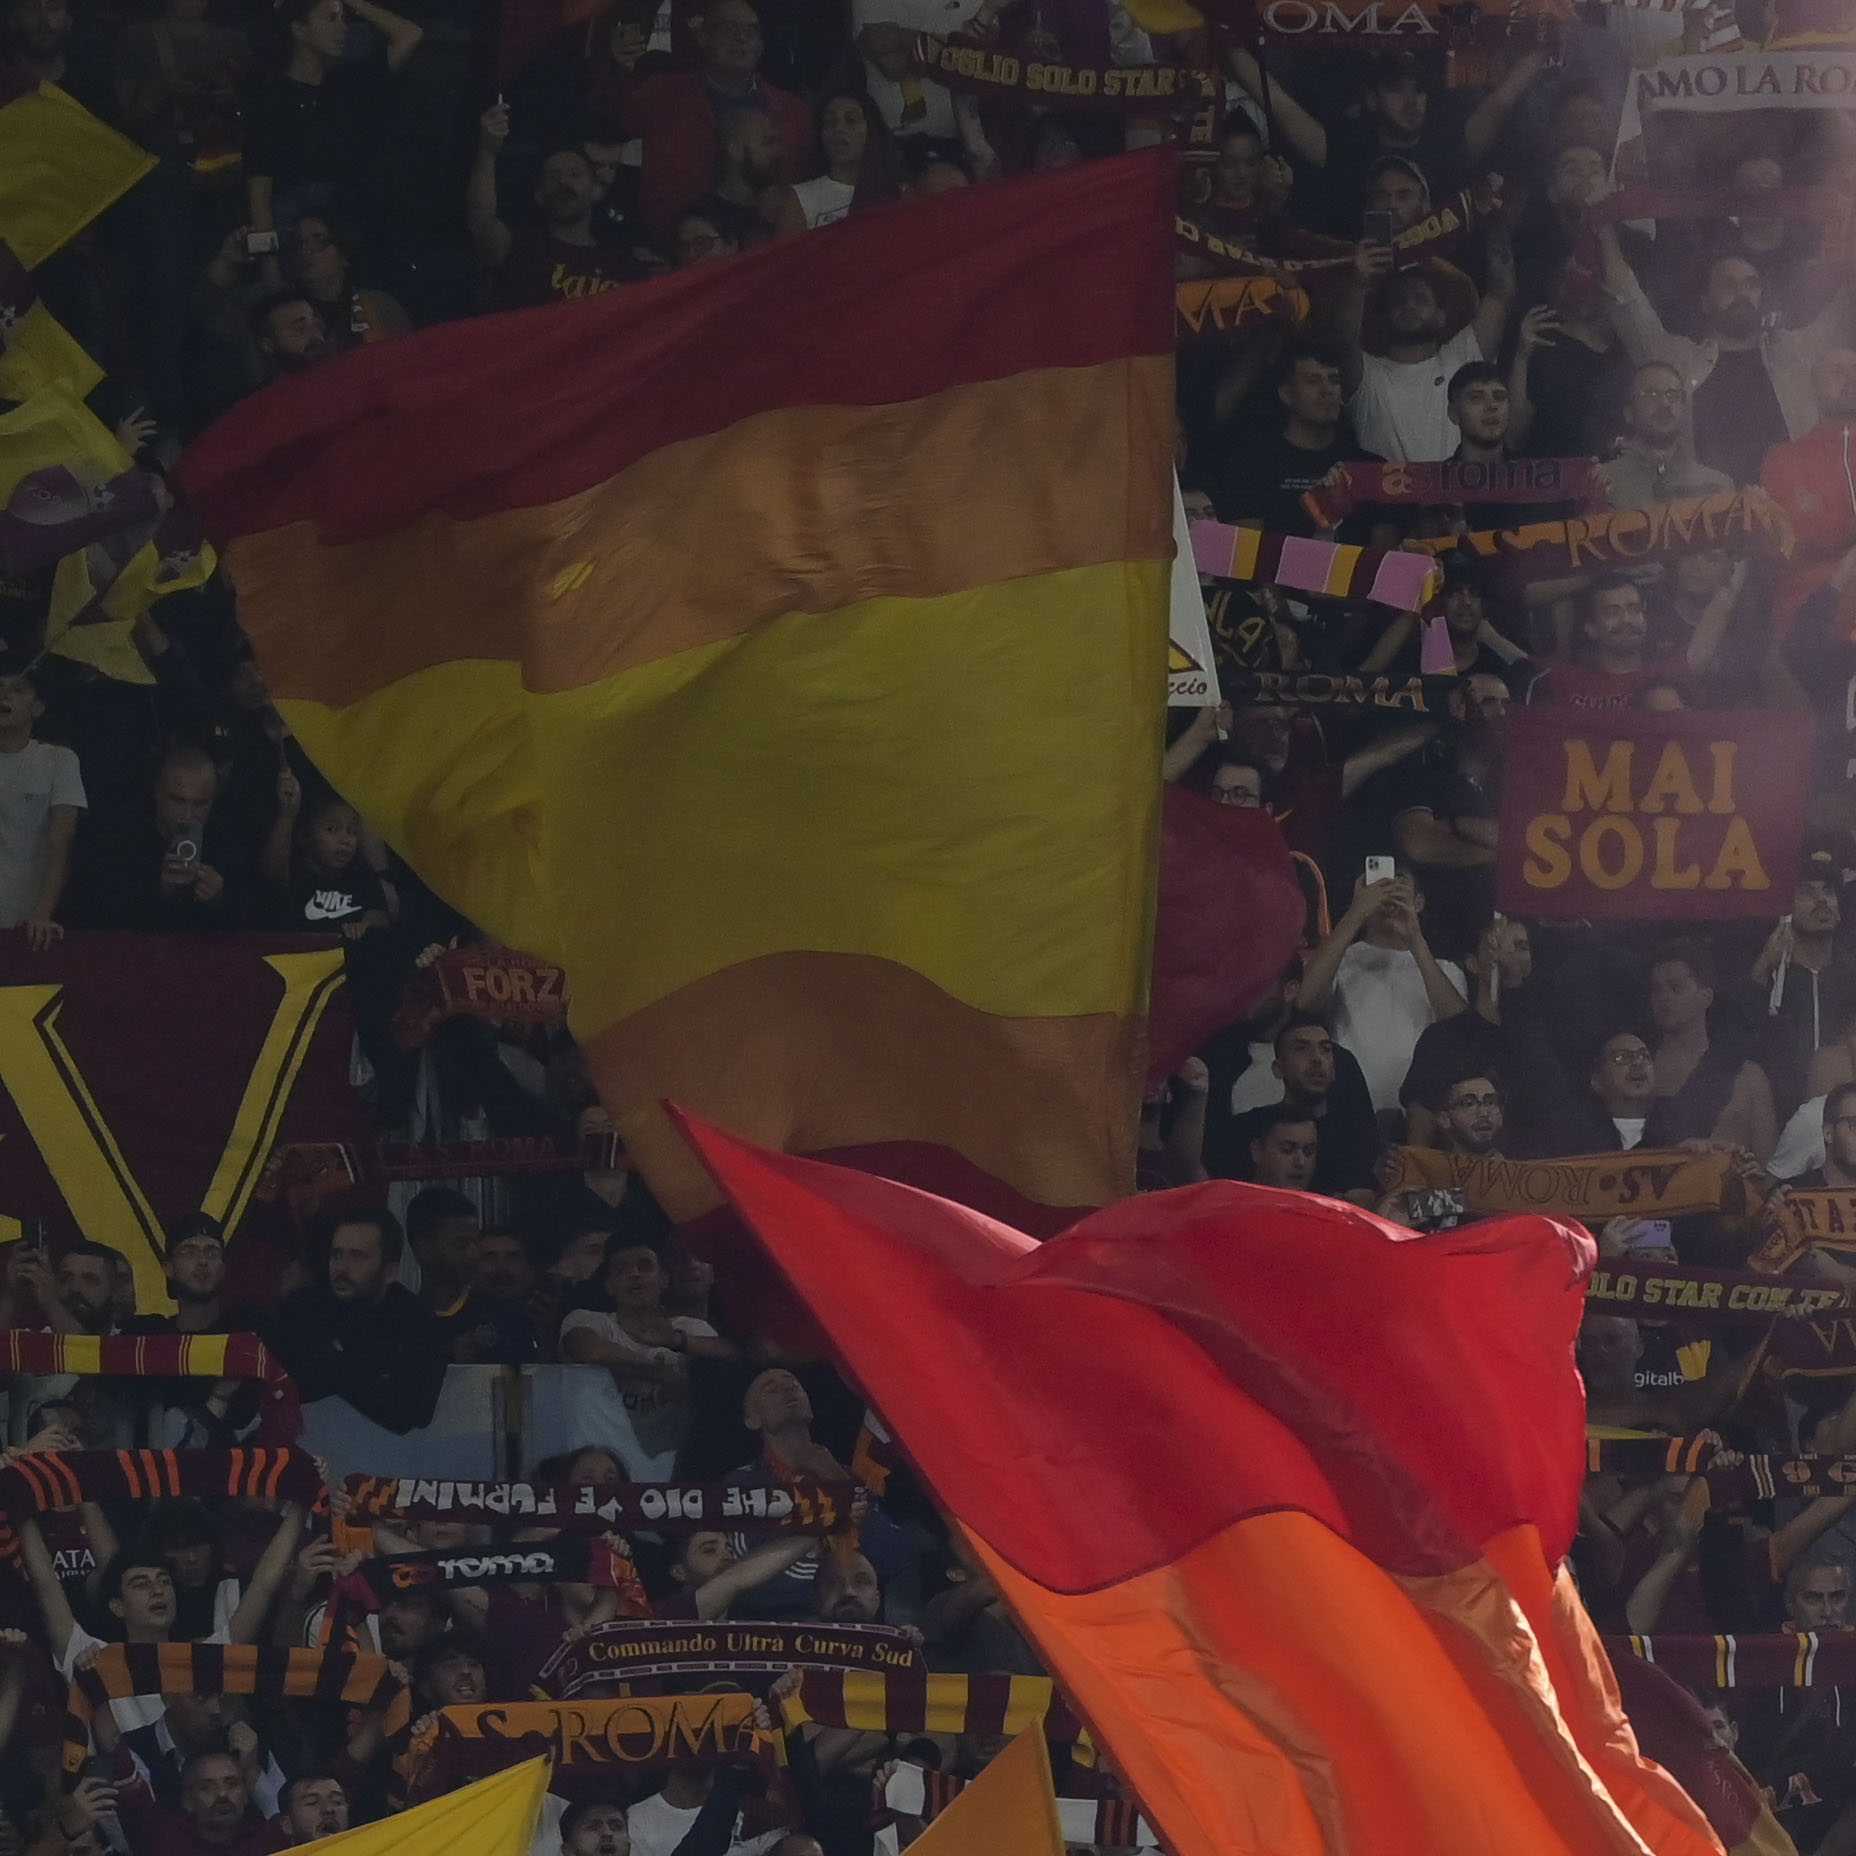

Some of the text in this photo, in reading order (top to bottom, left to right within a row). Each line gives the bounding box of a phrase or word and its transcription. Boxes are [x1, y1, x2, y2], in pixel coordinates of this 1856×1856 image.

[1026, 61, 1098, 97] SOLO
[1440, 459, 1563, 491] roma
[1563, 738, 1739, 814] MAI
[1521, 815, 1771, 891] SOLA
[316, 889, 353, 911] NIKE
[463, 966, 567, 1002] FORZ
[1642, 1277, 1723, 1309] STAR
[639, 1487, 704, 1520] DIO
[721, 1485, 795, 1519] CHE
[437, 1552, 557, 1581] roma
[588, 1632, 915, 1668] Commando Ultrà Curva Sud
